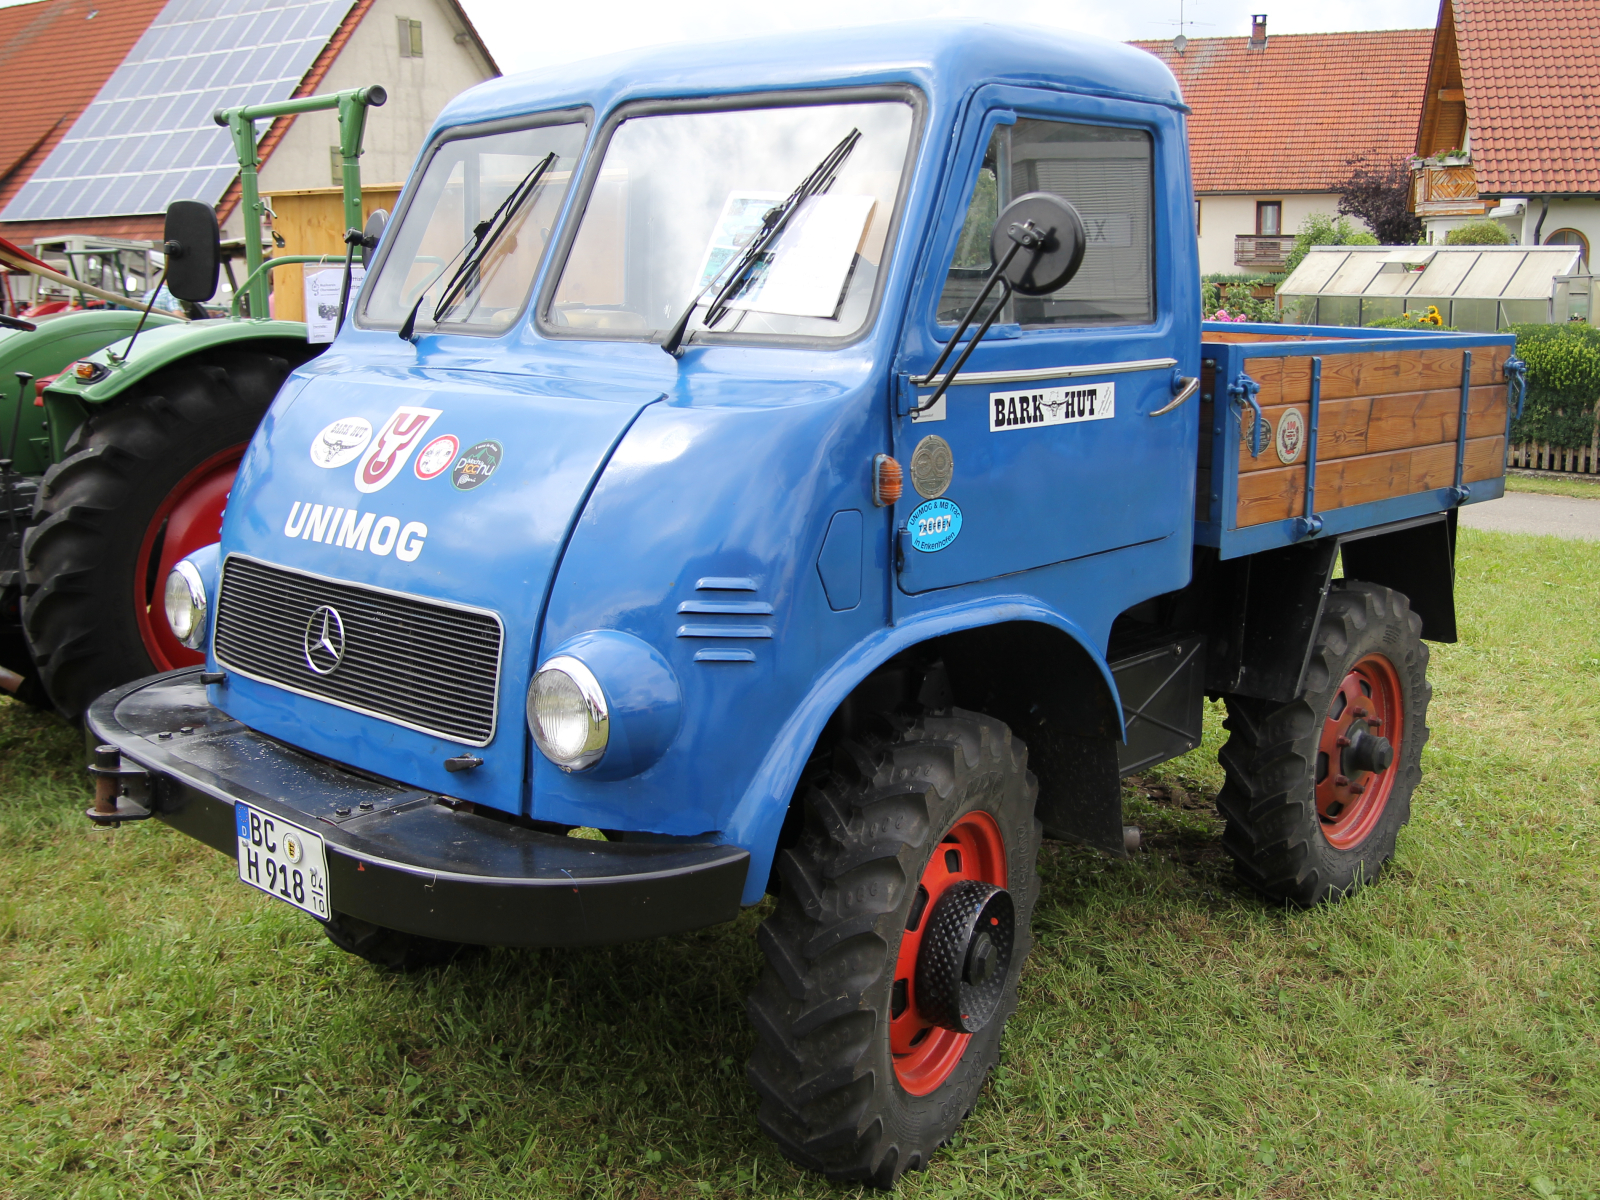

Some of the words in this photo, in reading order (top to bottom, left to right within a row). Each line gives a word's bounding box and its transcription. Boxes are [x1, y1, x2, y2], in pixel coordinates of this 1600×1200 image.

[994, 394, 1044, 427] BARK
[1064, 388, 1097, 419] HUT
[909, 502, 932, 526] UNIMOG
[939, 501, 949, 509] MB
[950, 503, 961, 518] Trac
[918, 514, 952, 537] 2007
[284, 501, 428, 562] UNIMOG
[242, 826, 247, 836] D
[250, 812, 277, 853] BC
[247, 847, 260, 883] H
[266, 858, 305, 904] 918
[312, 896, 325, 913] 10
